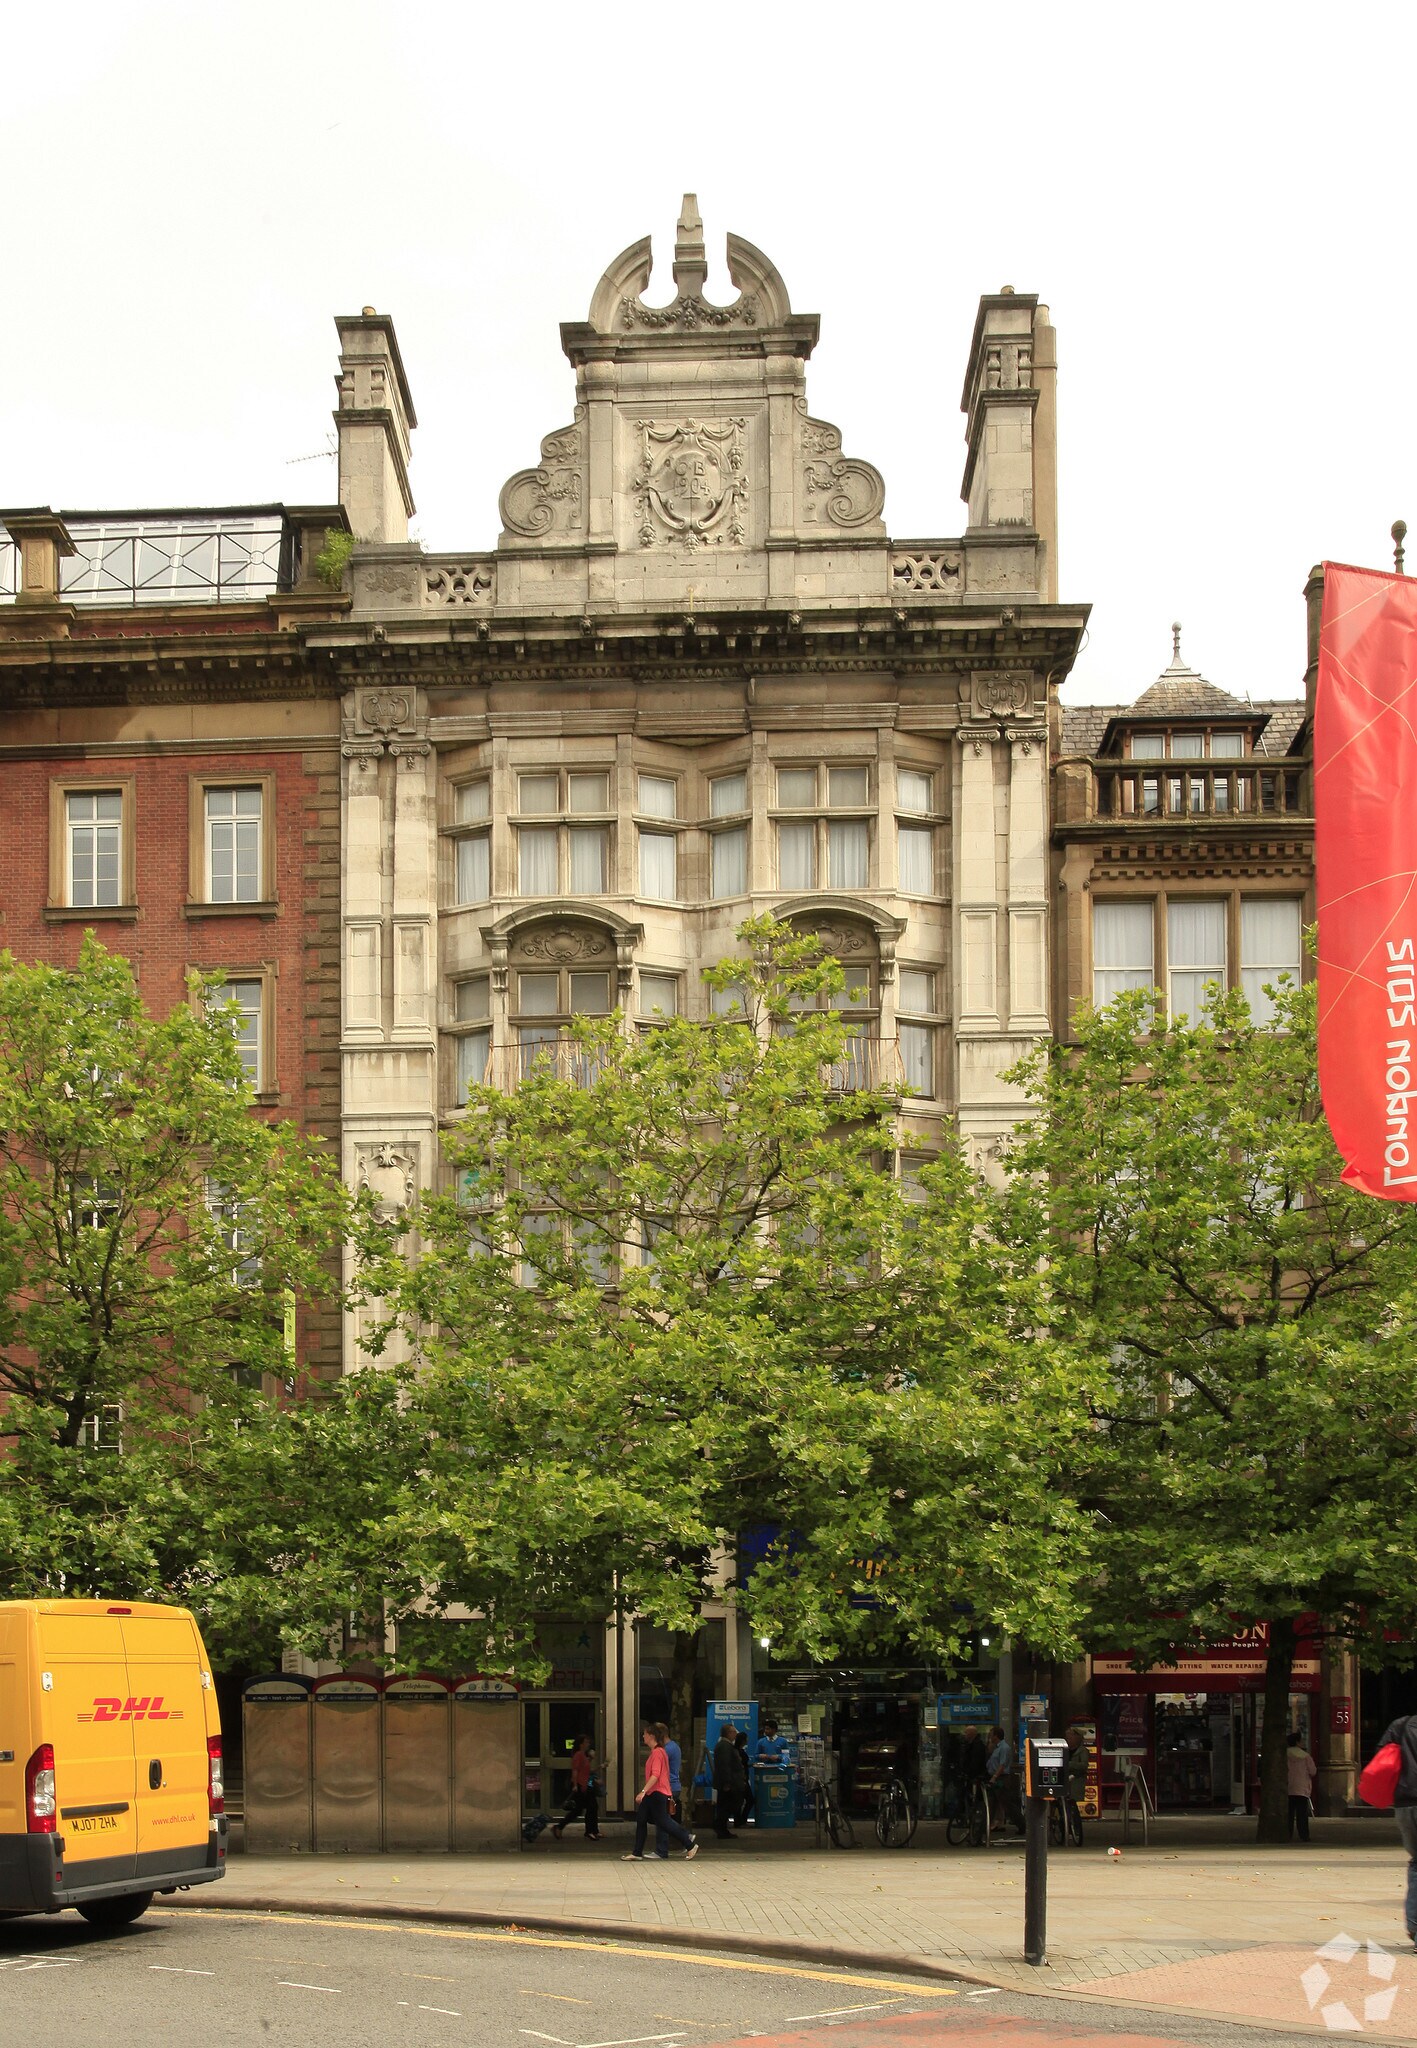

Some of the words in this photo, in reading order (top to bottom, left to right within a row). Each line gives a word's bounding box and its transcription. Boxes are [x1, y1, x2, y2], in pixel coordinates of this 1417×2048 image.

[1232, 1641, 1260, 1649] People
[93, 1697, 170, 1722] DHL
[960, 1704, 988, 1712] Lebara
[1119, 1716, 1144, 1724] Price
[1335, 1711, 1349, 1724] 55
[71, 1818, 97, 1832] MJ07
[100, 1816, 118, 1829] ZHA
[151, 1813, 196, 1826] www.dhl.co.uk
